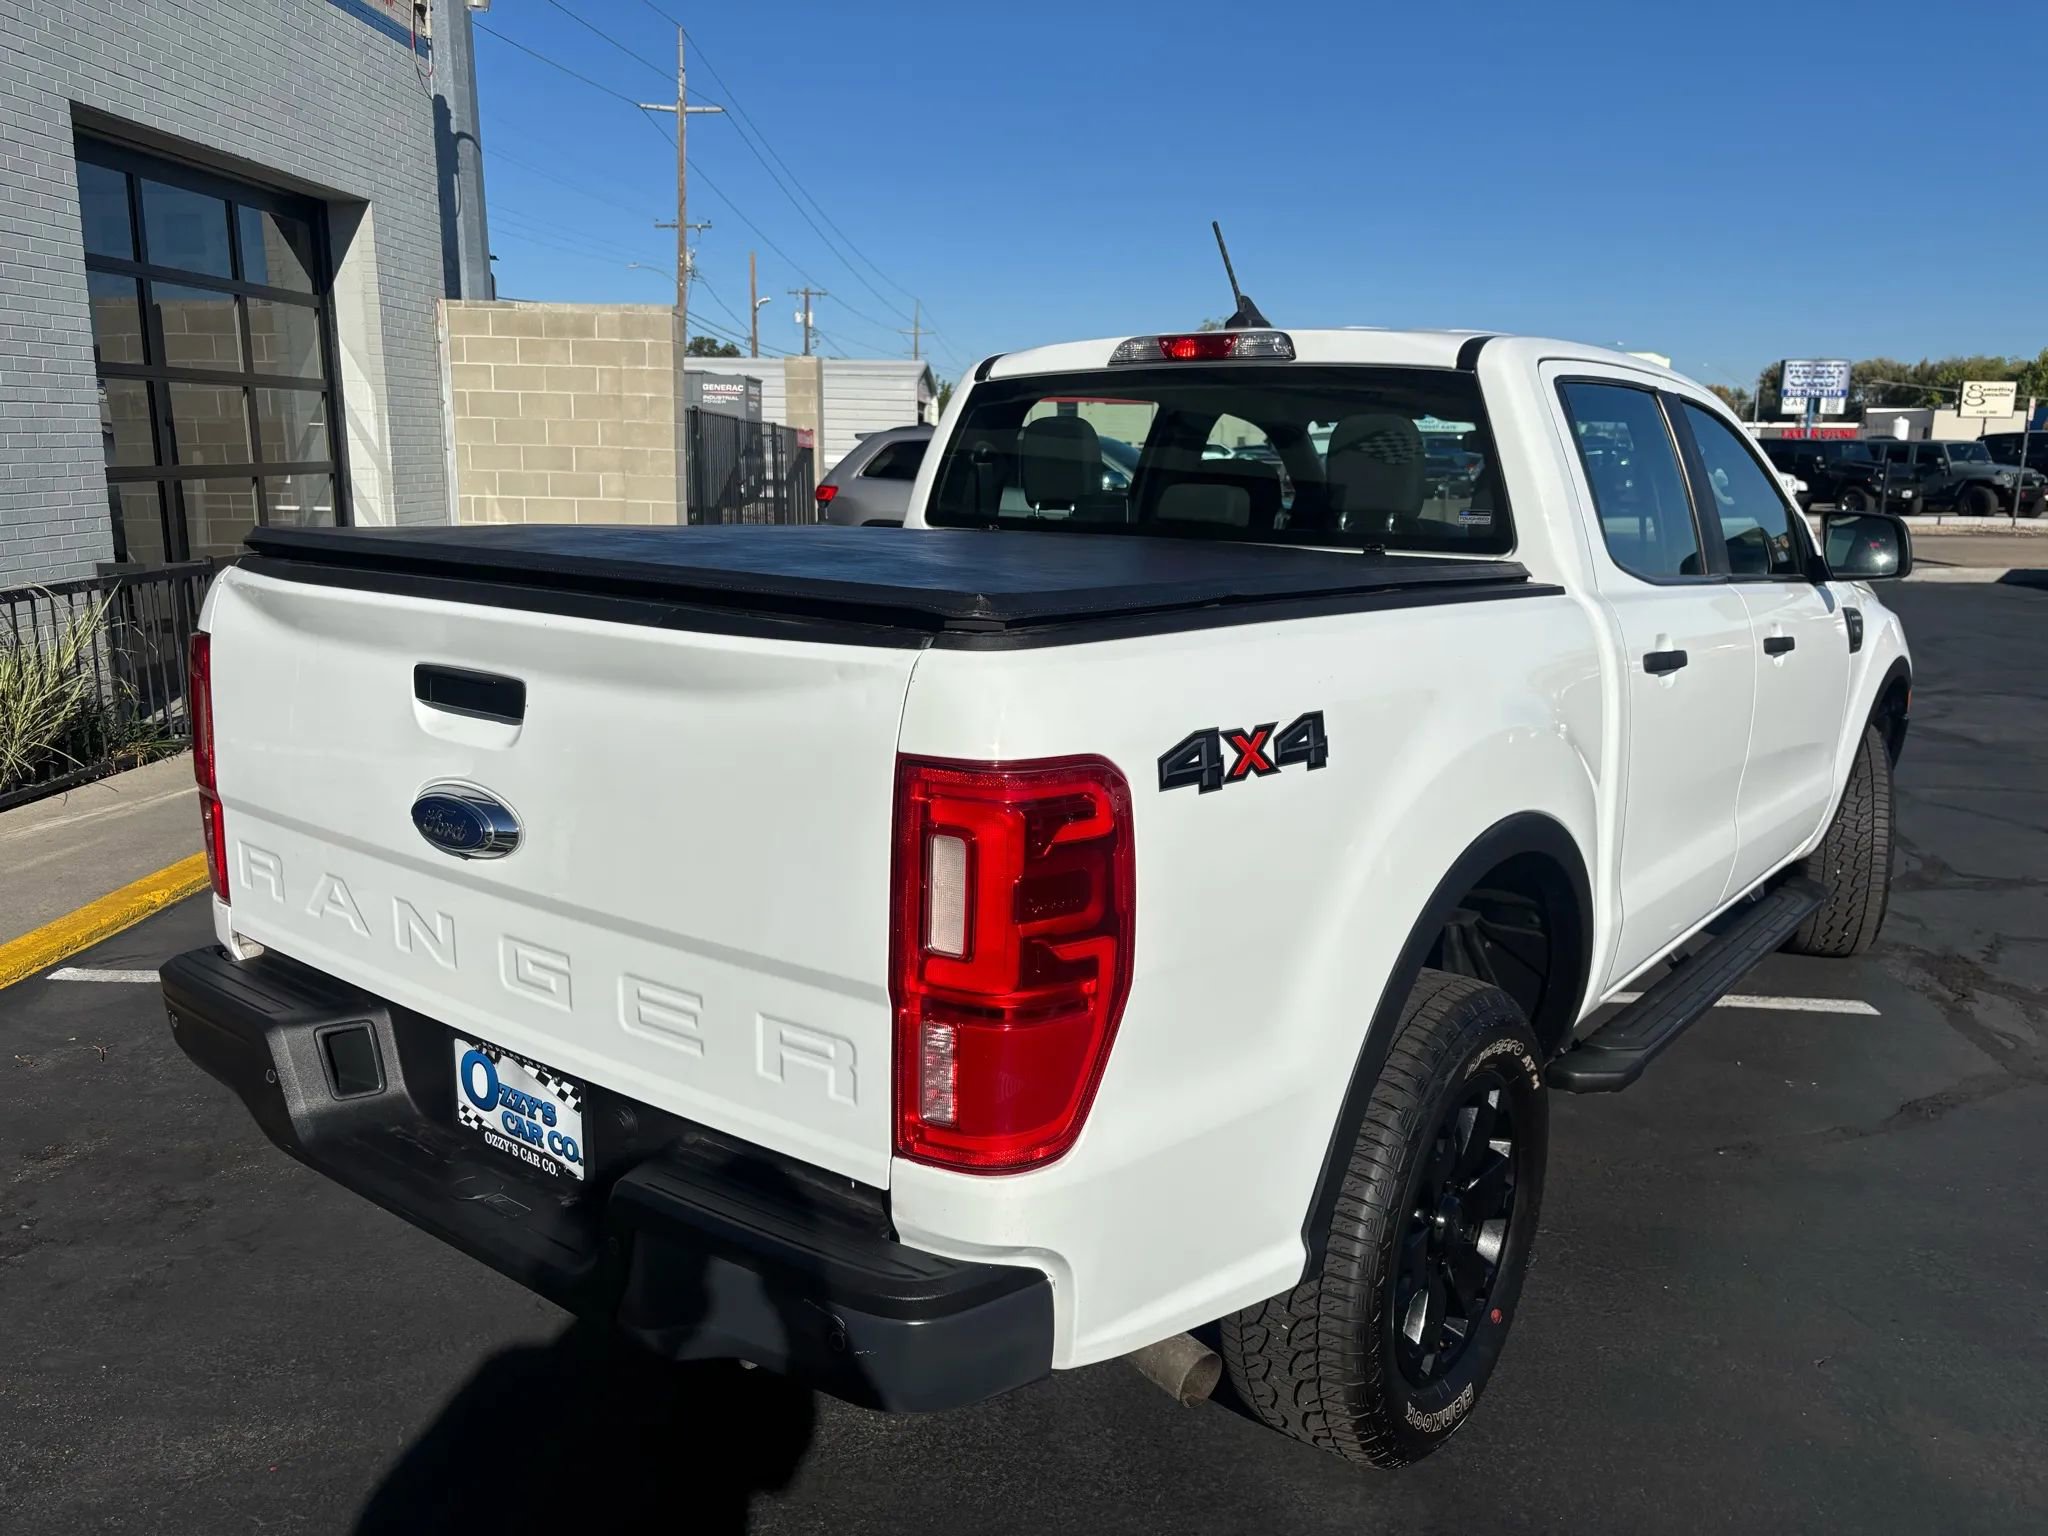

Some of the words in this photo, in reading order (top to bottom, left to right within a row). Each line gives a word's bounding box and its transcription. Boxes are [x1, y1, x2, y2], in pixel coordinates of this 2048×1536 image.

[703, 383, 744, 391] GENERAC
[423, 807, 467, 841] Ford
[238, 838, 858, 1106] RANGER
[461, 1050, 557, 1127] OZZY'S
[485, 1131, 518, 1157] OZZY'S
[520, 1147, 540, 1168] CAR
[542, 1158, 559, 1177] CO.
[501, 1110, 544, 1150] CAR
[547, 1130, 583, 1166] CO.
